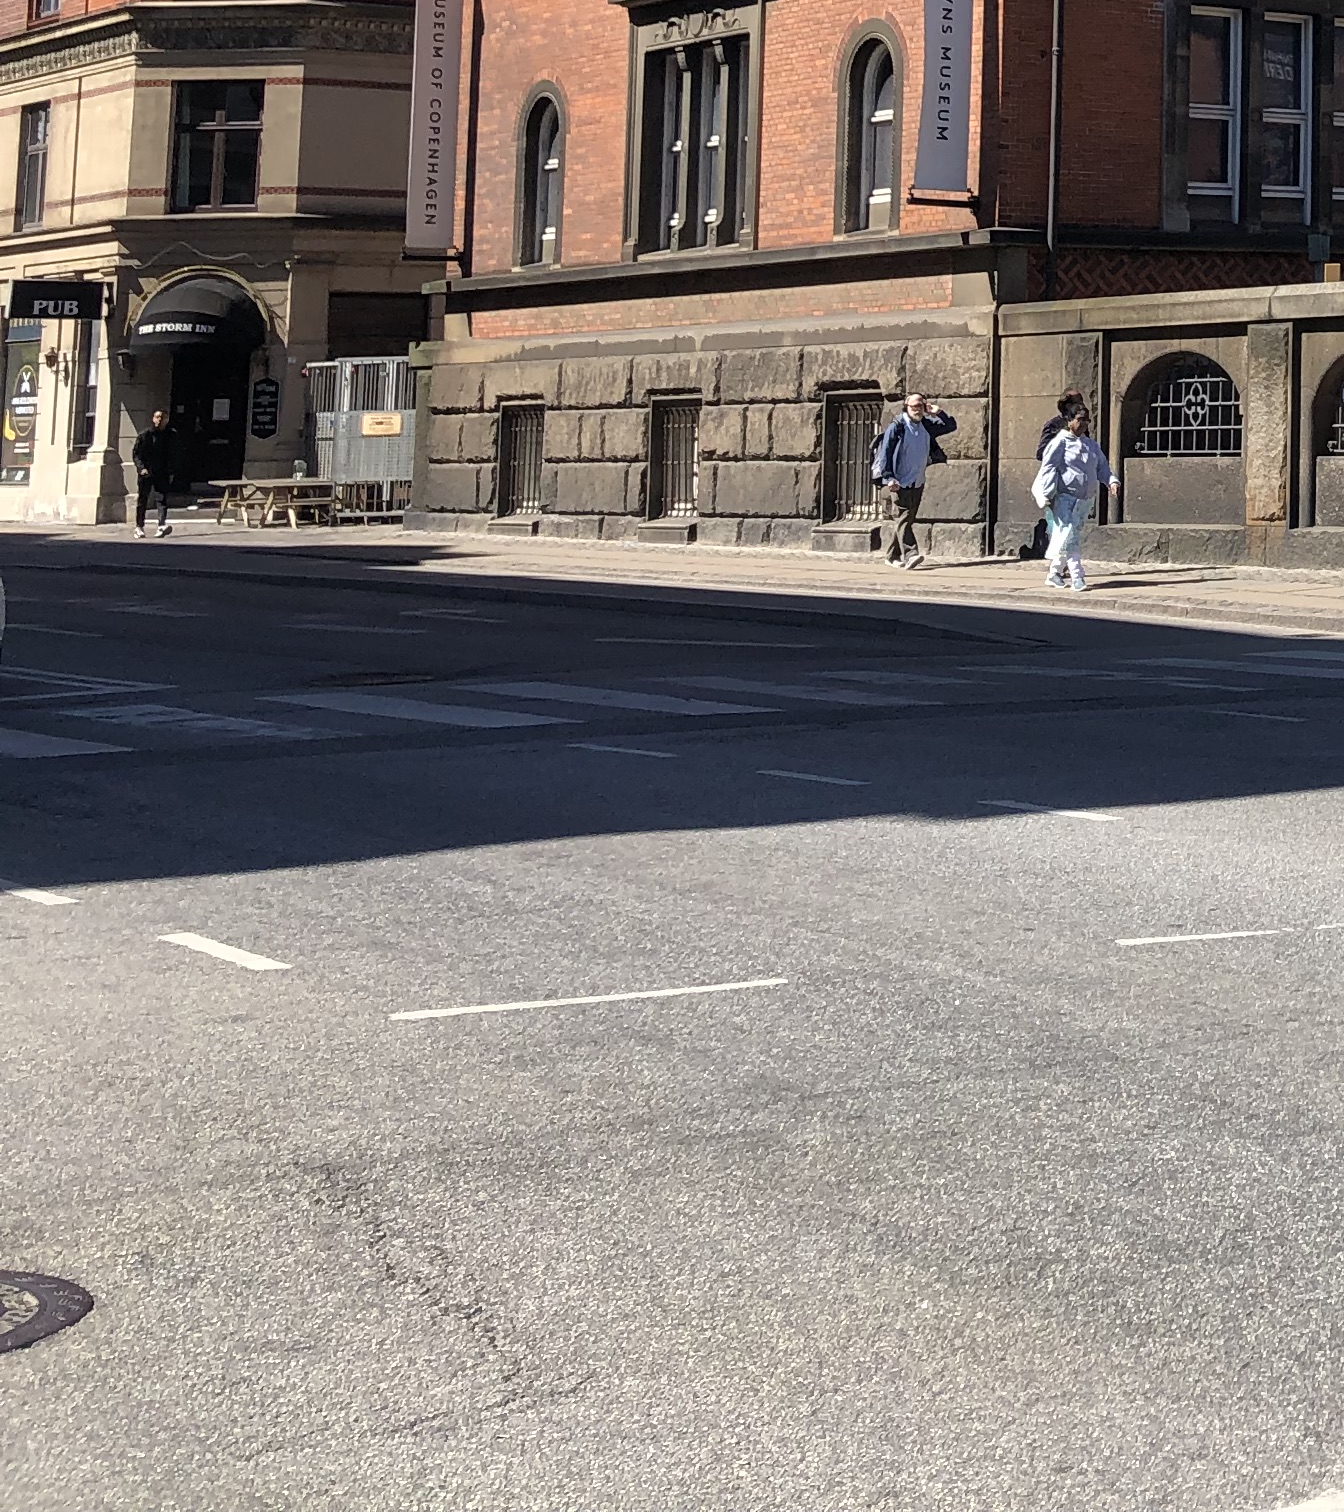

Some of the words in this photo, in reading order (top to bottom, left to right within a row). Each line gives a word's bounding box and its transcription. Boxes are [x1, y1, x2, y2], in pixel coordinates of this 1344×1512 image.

[430, 67, 444, 91] OF
[935, 45, 957, 143] MUSEUM
[424, 97, 443, 226] COPENHAGEN
[32, 299, 79, 316] PUB
[154, 321, 193, 333] STORM
[194, 323, 216, 334] INN
